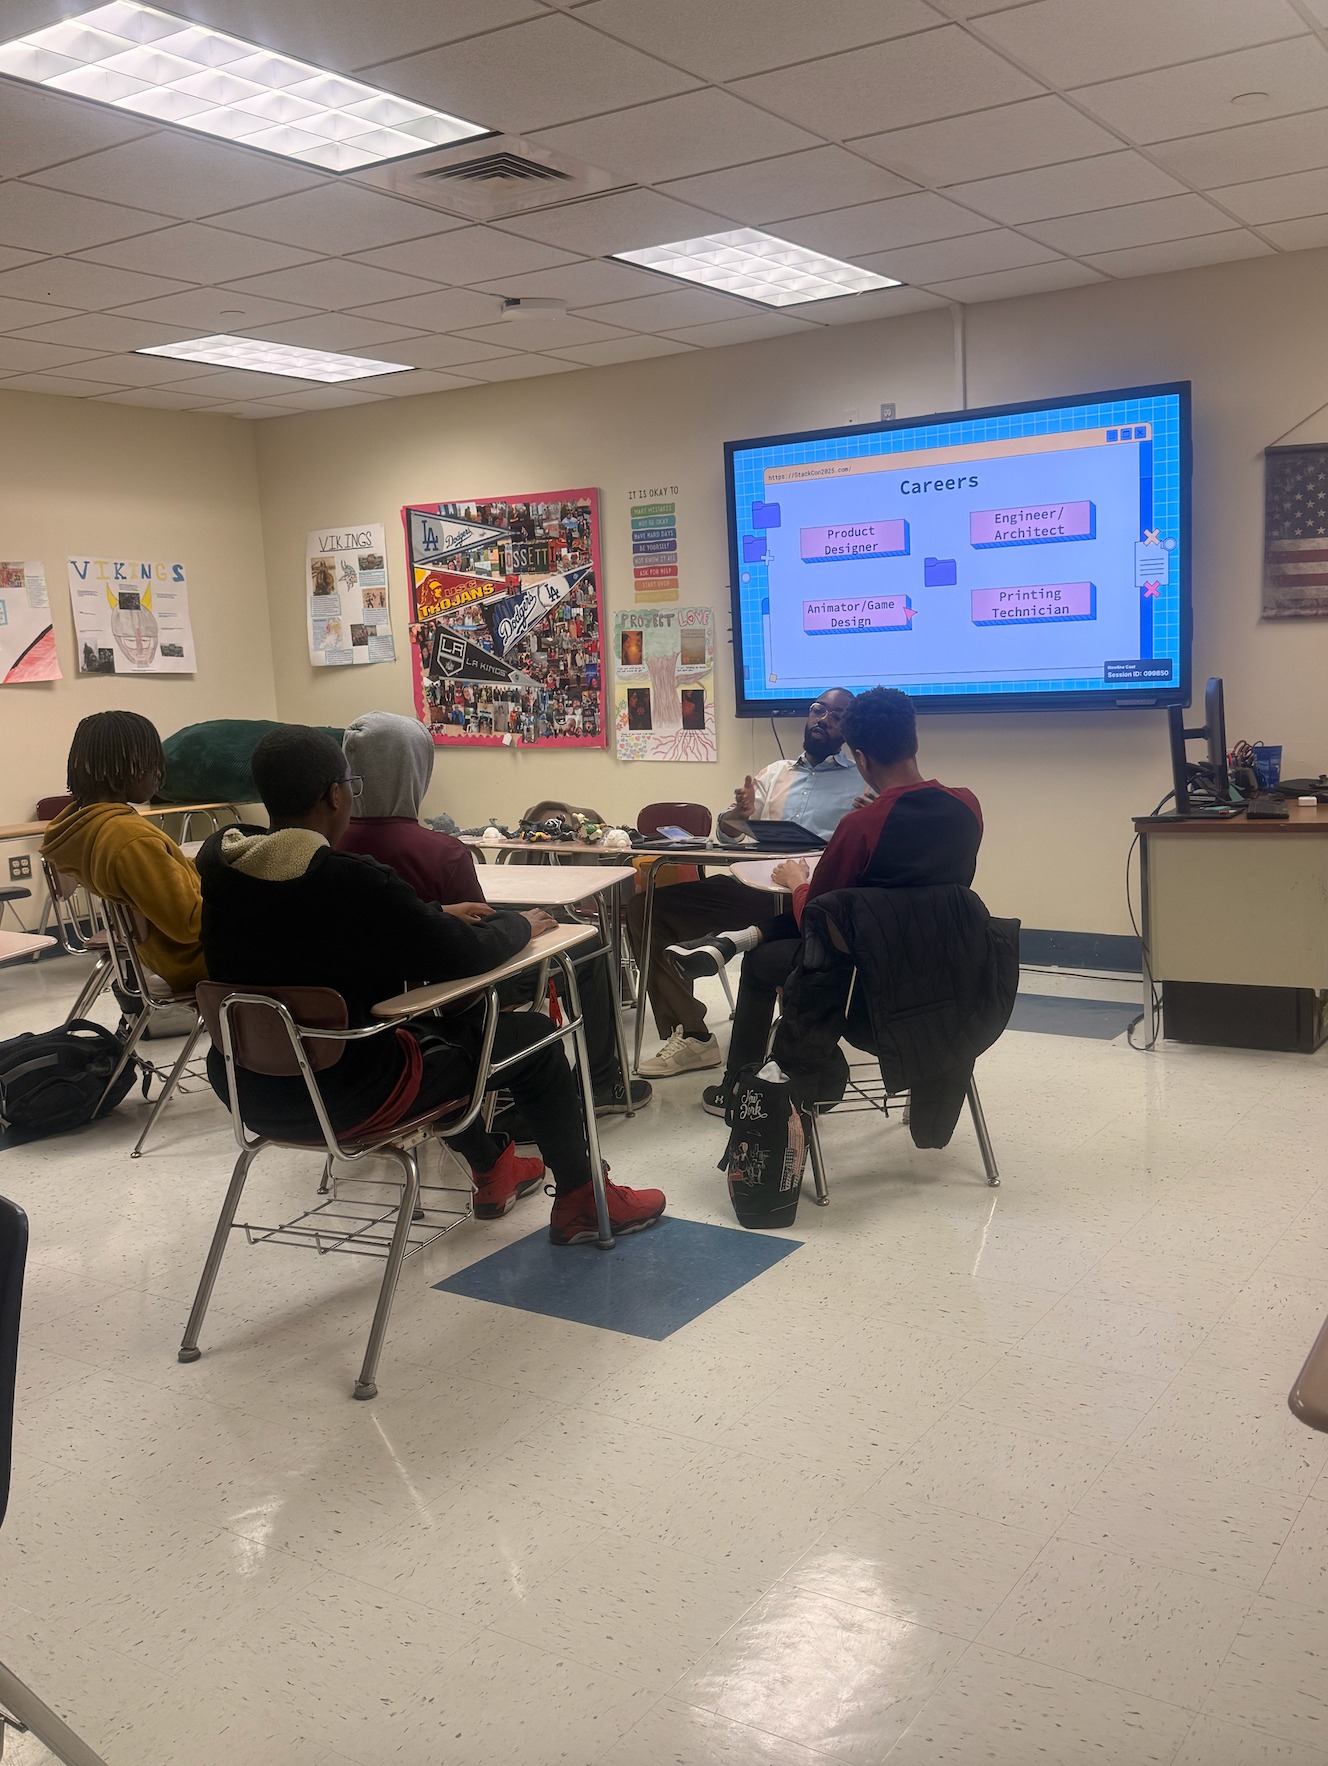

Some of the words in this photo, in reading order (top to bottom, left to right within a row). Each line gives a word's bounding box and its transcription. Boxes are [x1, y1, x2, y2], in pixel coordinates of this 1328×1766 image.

[768, 466, 852, 481] https://StackCon2025.com/
[629, 491, 637, 500] IT
[639, 490, 647, 499] IS
[649, 487, 668, 498] OKAY
[671, 486, 679, 495] TO
[900, 475, 979, 495] Careers
[648, 504, 672, 514] MISTAKES
[994, 506, 1065, 526] Engineer/
[656, 518, 669, 526] OKAY
[318, 531, 373, 551] VIKINGS
[421, 520, 439, 552] LA
[445, 527, 473, 549] Dodgers
[634, 532, 646, 540] HAVE
[827, 526, 876, 540] Product
[994, 524, 1065, 541] Architect
[647, 542, 670, 551] YOURSELF
[824, 542, 879, 556] Designer
[498, 545, 556, 568] TOSSETTI
[70, 560, 186, 582] VIKINGS
[660, 567, 672, 575] HELP
[444, 580, 477, 598] USC
[546, 583, 561, 603] LA
[999, 588, 1062, 602] Printing
[420, 583, 495, 617] TROJANS
[807, 600, 895, 614] Animator/Game
[498, 590, 538, 644] Dodgers
[620, 613, 676, 629] PROJECT
[677, 610, 710, 628] LOVE
[992, 604, 1070, 619] Technician
[831, 616, 871, 629] Design
[441, 638, 464, 658] LA
[465, 657, 478, 668] LA
[479, 663, 507, 678] KINGS
[740, 1089, 763, 1104] New
[740, 1100, 768, 1120] York
